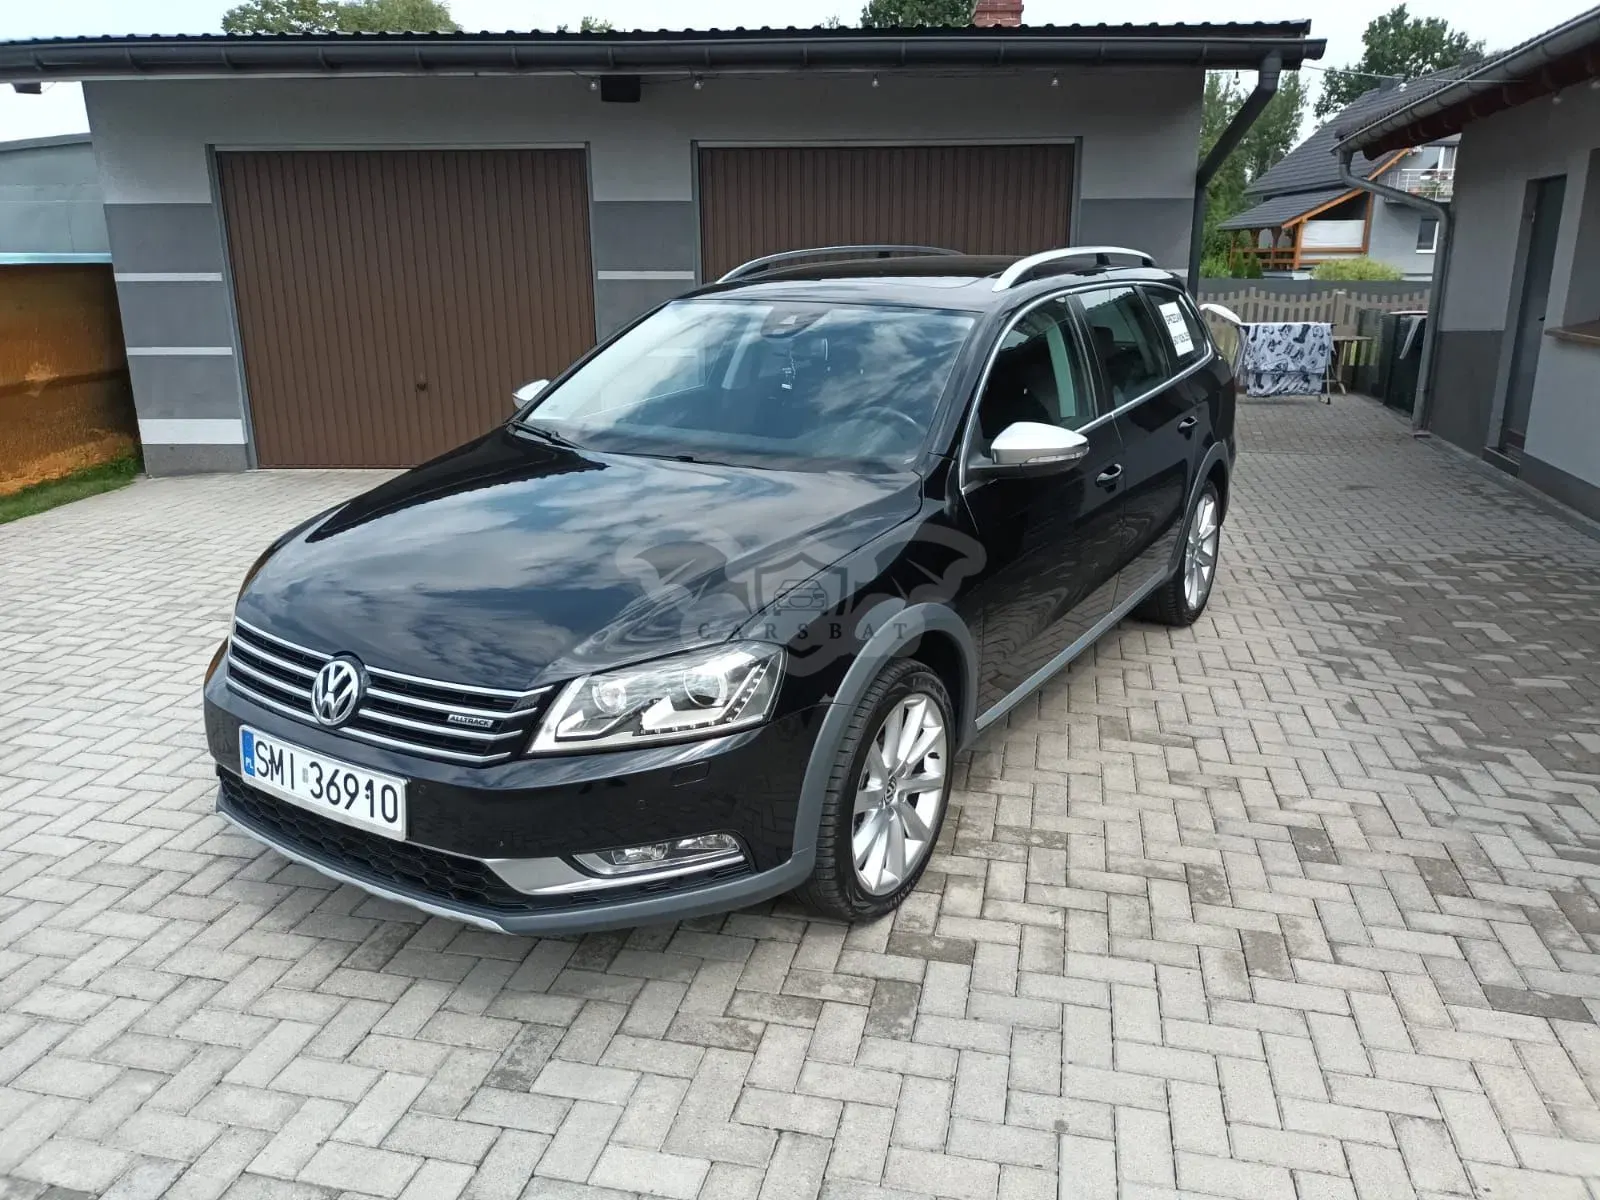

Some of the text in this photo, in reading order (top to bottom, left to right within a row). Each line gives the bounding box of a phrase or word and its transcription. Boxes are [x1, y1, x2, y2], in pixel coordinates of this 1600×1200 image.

[449, 715, 491, 728] ALLTRACK
[255, 740, 398, 824] SMI 36910
